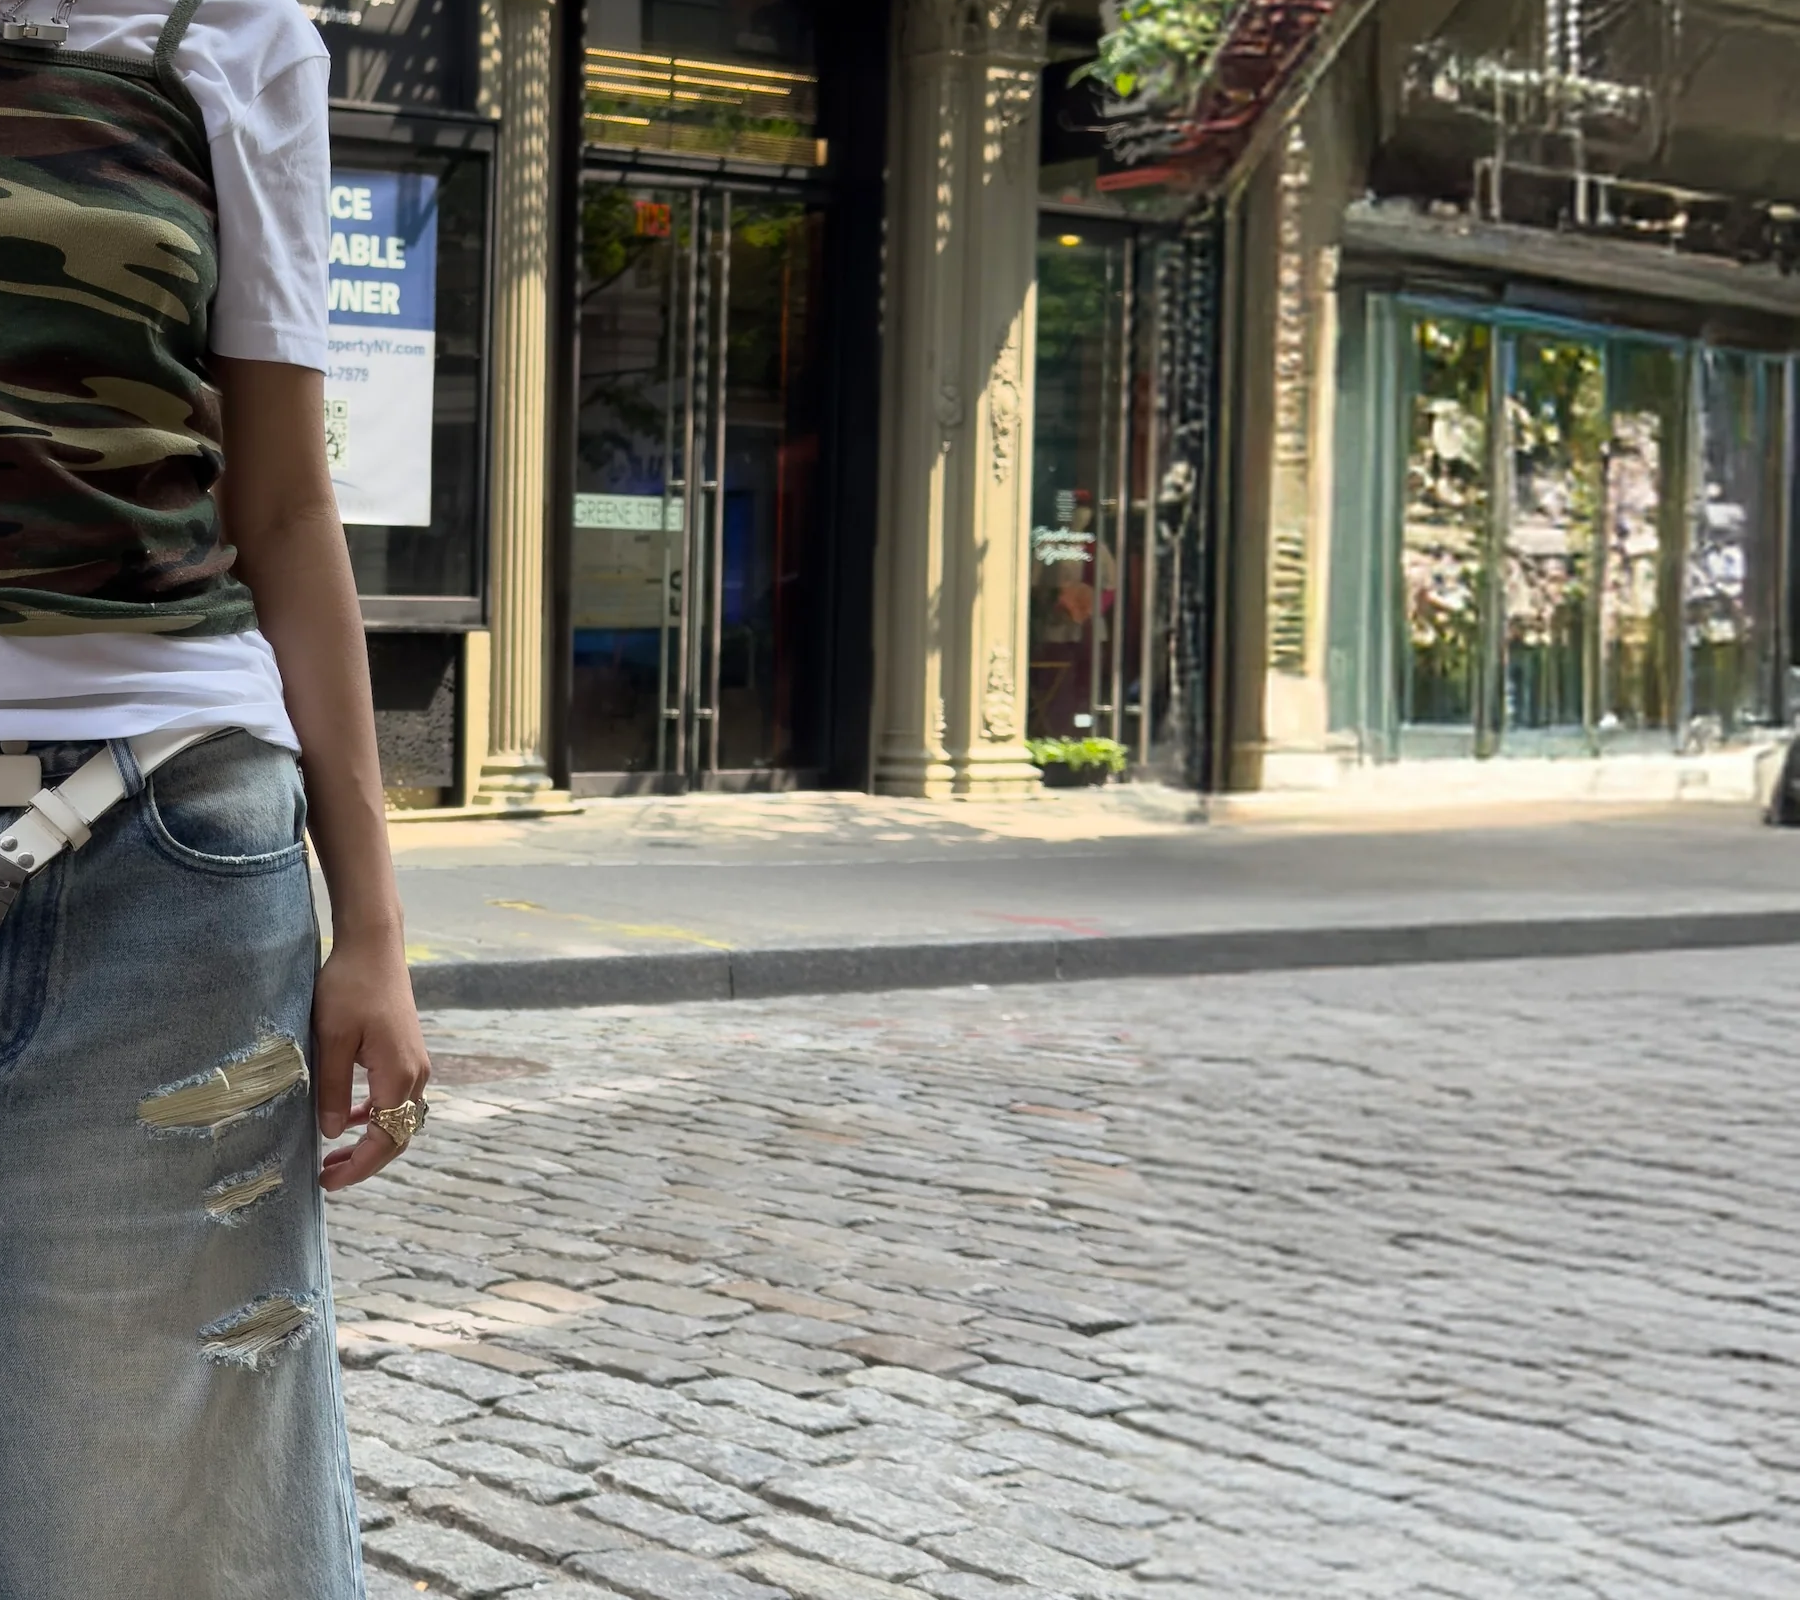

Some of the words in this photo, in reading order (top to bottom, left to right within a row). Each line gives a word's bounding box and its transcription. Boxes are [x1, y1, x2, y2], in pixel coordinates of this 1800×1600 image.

[329, 185, 373, 221] CE
[575, 498, 633, 525] GREENE
[637, 501, 684, 528] STRET
